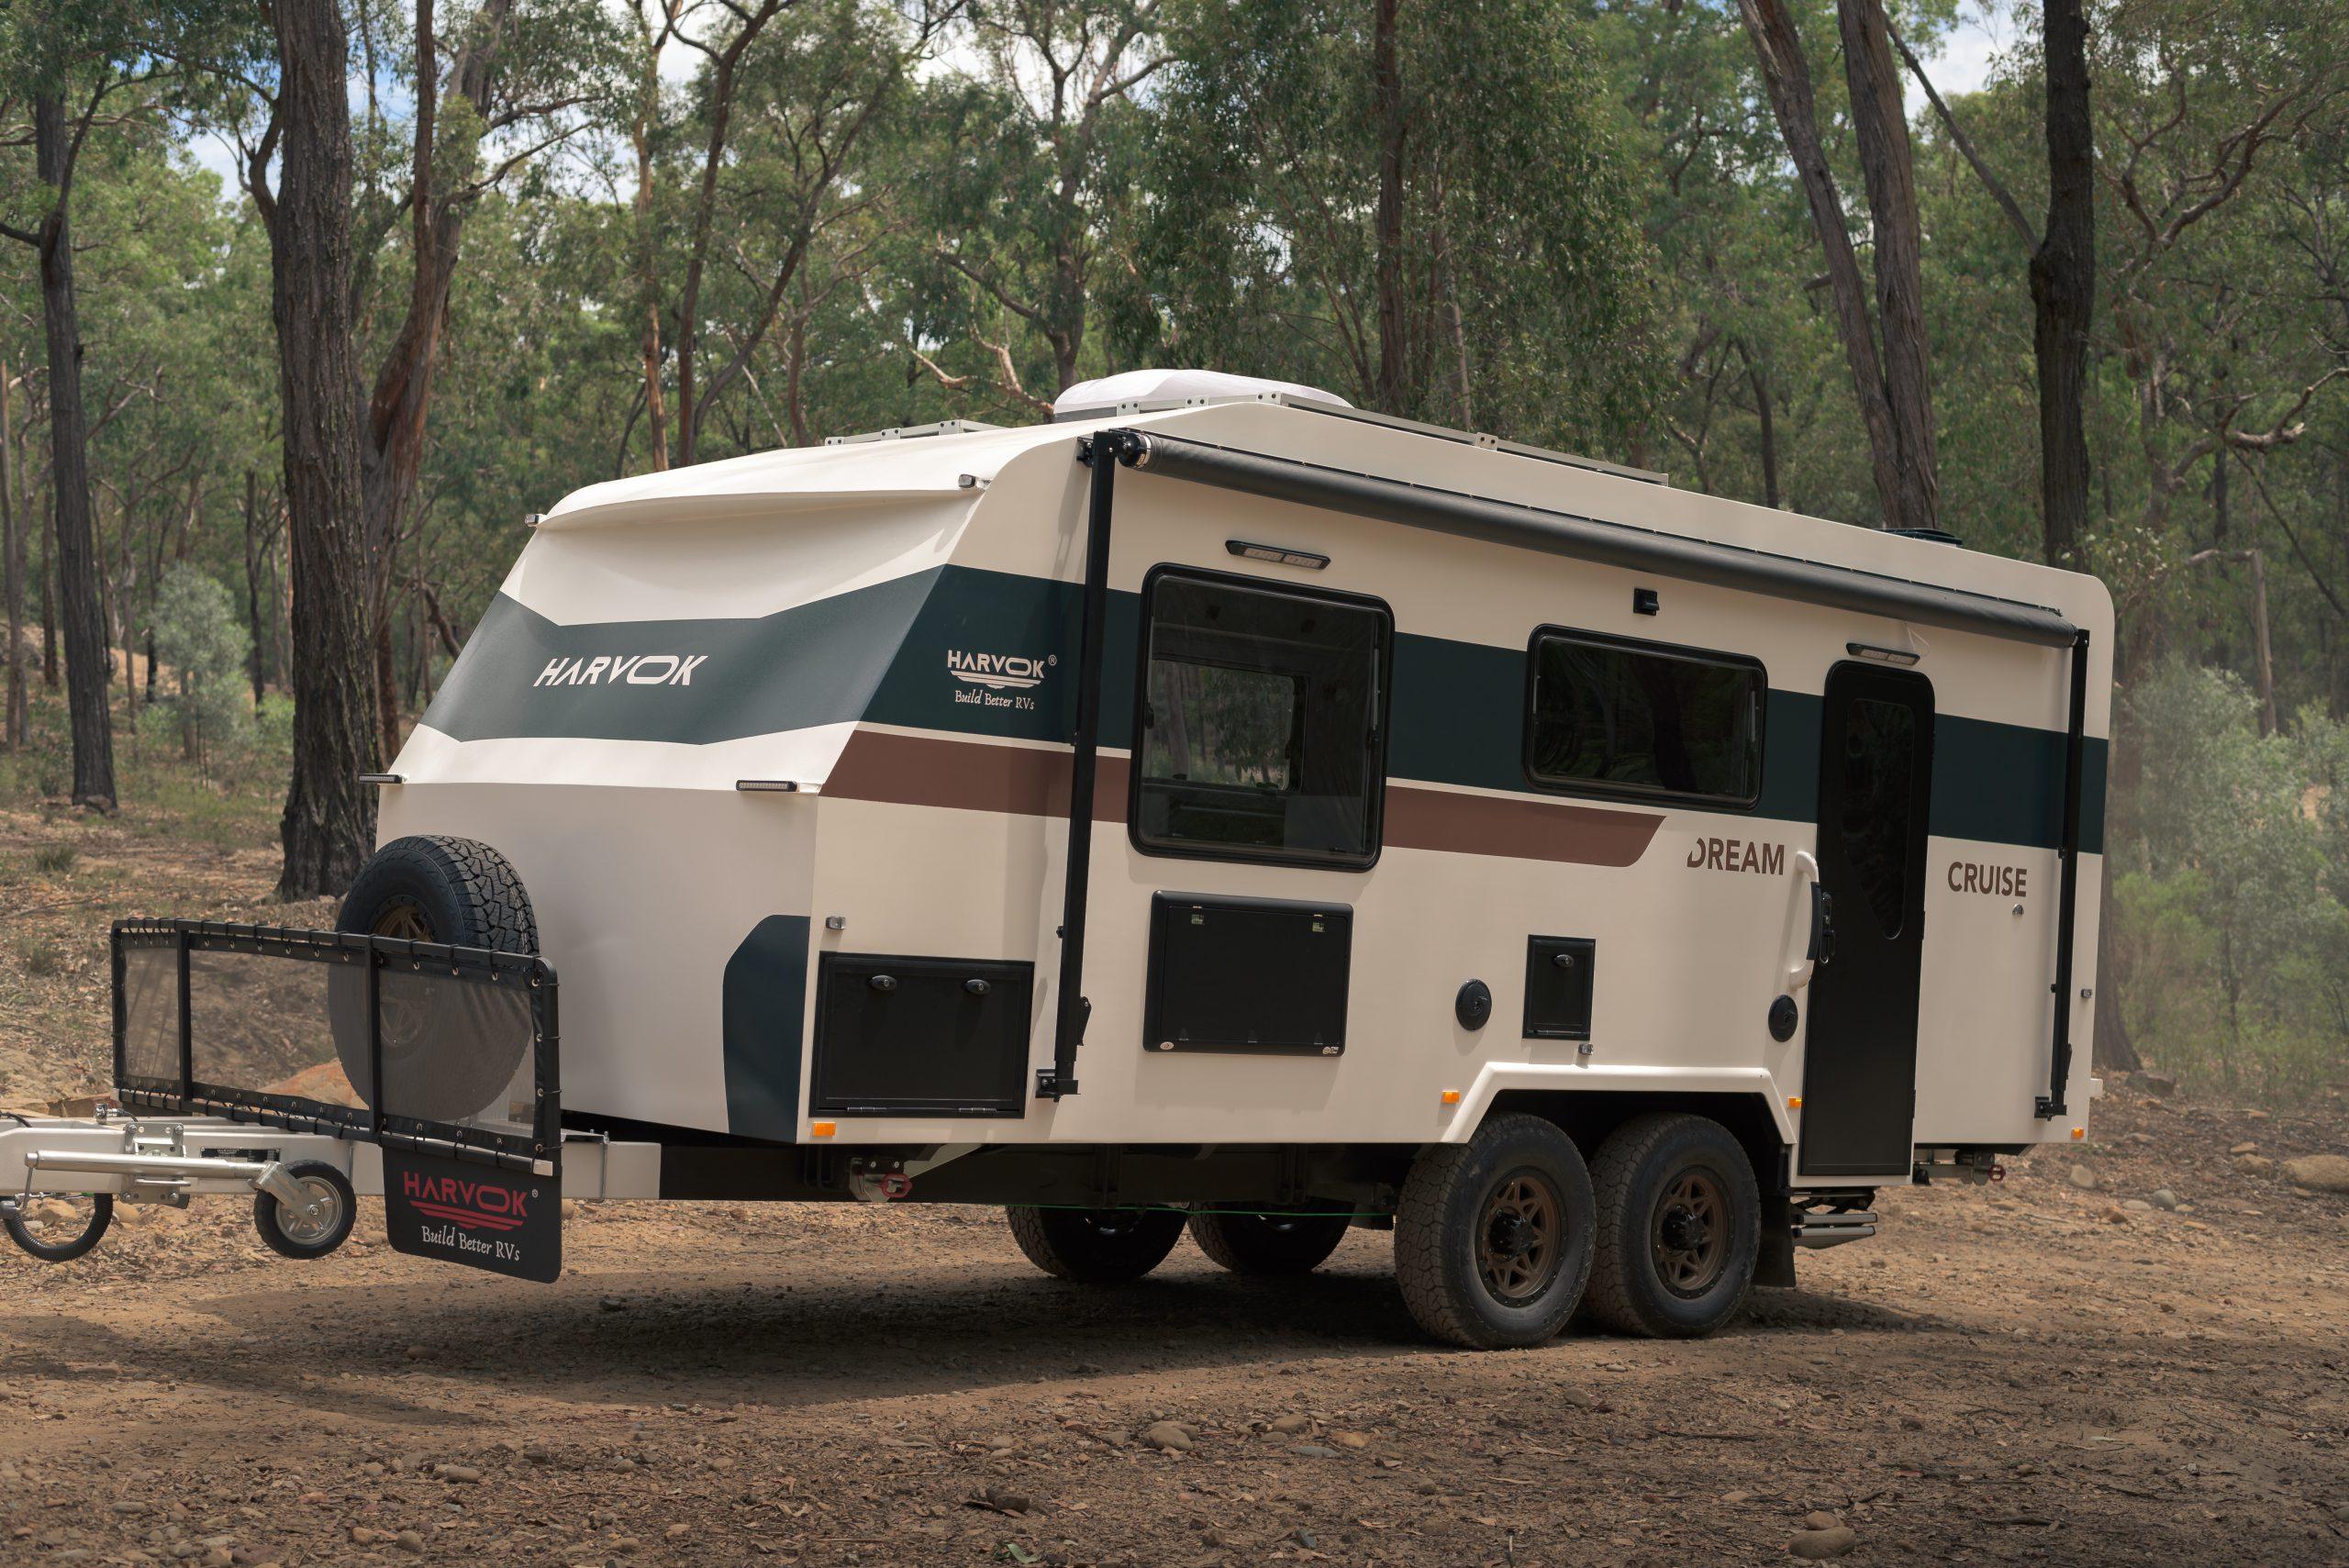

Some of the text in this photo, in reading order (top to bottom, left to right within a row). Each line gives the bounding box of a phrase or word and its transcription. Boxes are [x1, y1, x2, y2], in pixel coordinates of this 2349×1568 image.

[532, 655, 709, 687] HARVOK
[947, 650, 1045, 679] HARVOK
[954, 688, 1035, 710] Build Better RVs
[1687, 837, 1785, 876] DREAM
[1947, 861, 2028, 897] CRUISE
[403, 1171, 529, 1218] HARVOK
[421, 1225, 520, 1262] Build Better RVs
